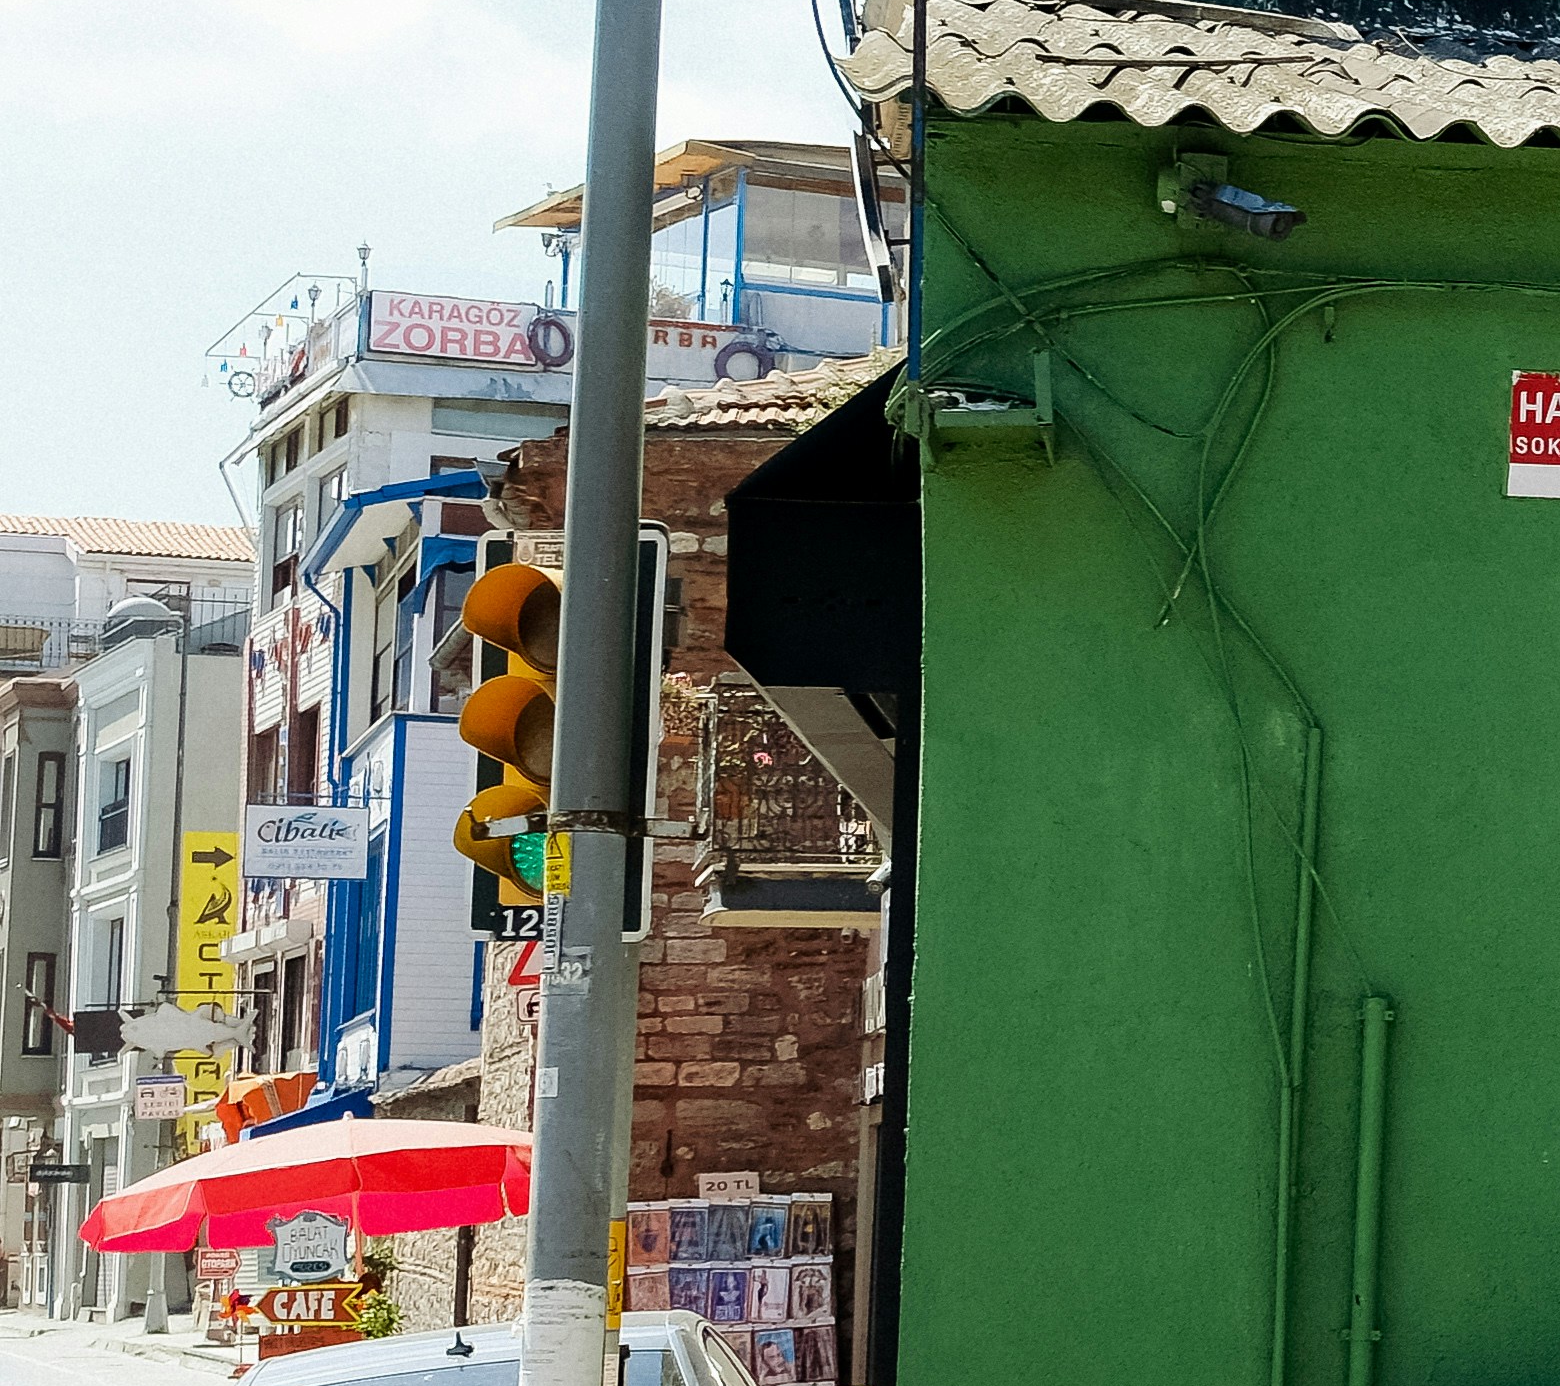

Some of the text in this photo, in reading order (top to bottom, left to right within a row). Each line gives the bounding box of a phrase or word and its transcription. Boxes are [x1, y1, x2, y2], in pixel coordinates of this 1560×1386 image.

[389, 299, 521, 329] KARAGÖZ
[372, 320, 534, 361] ZORBA
[653, 329, 717, 350] RBA
[502, 909, 540, 937] 12
[705, 1178, 754, 1192] 20 TL
[290, 1225, 328, 1243] BALAT
[282, 1240, 339, 1263] OYUNCAK
[273, 1290, 336, 1320] CAFE
